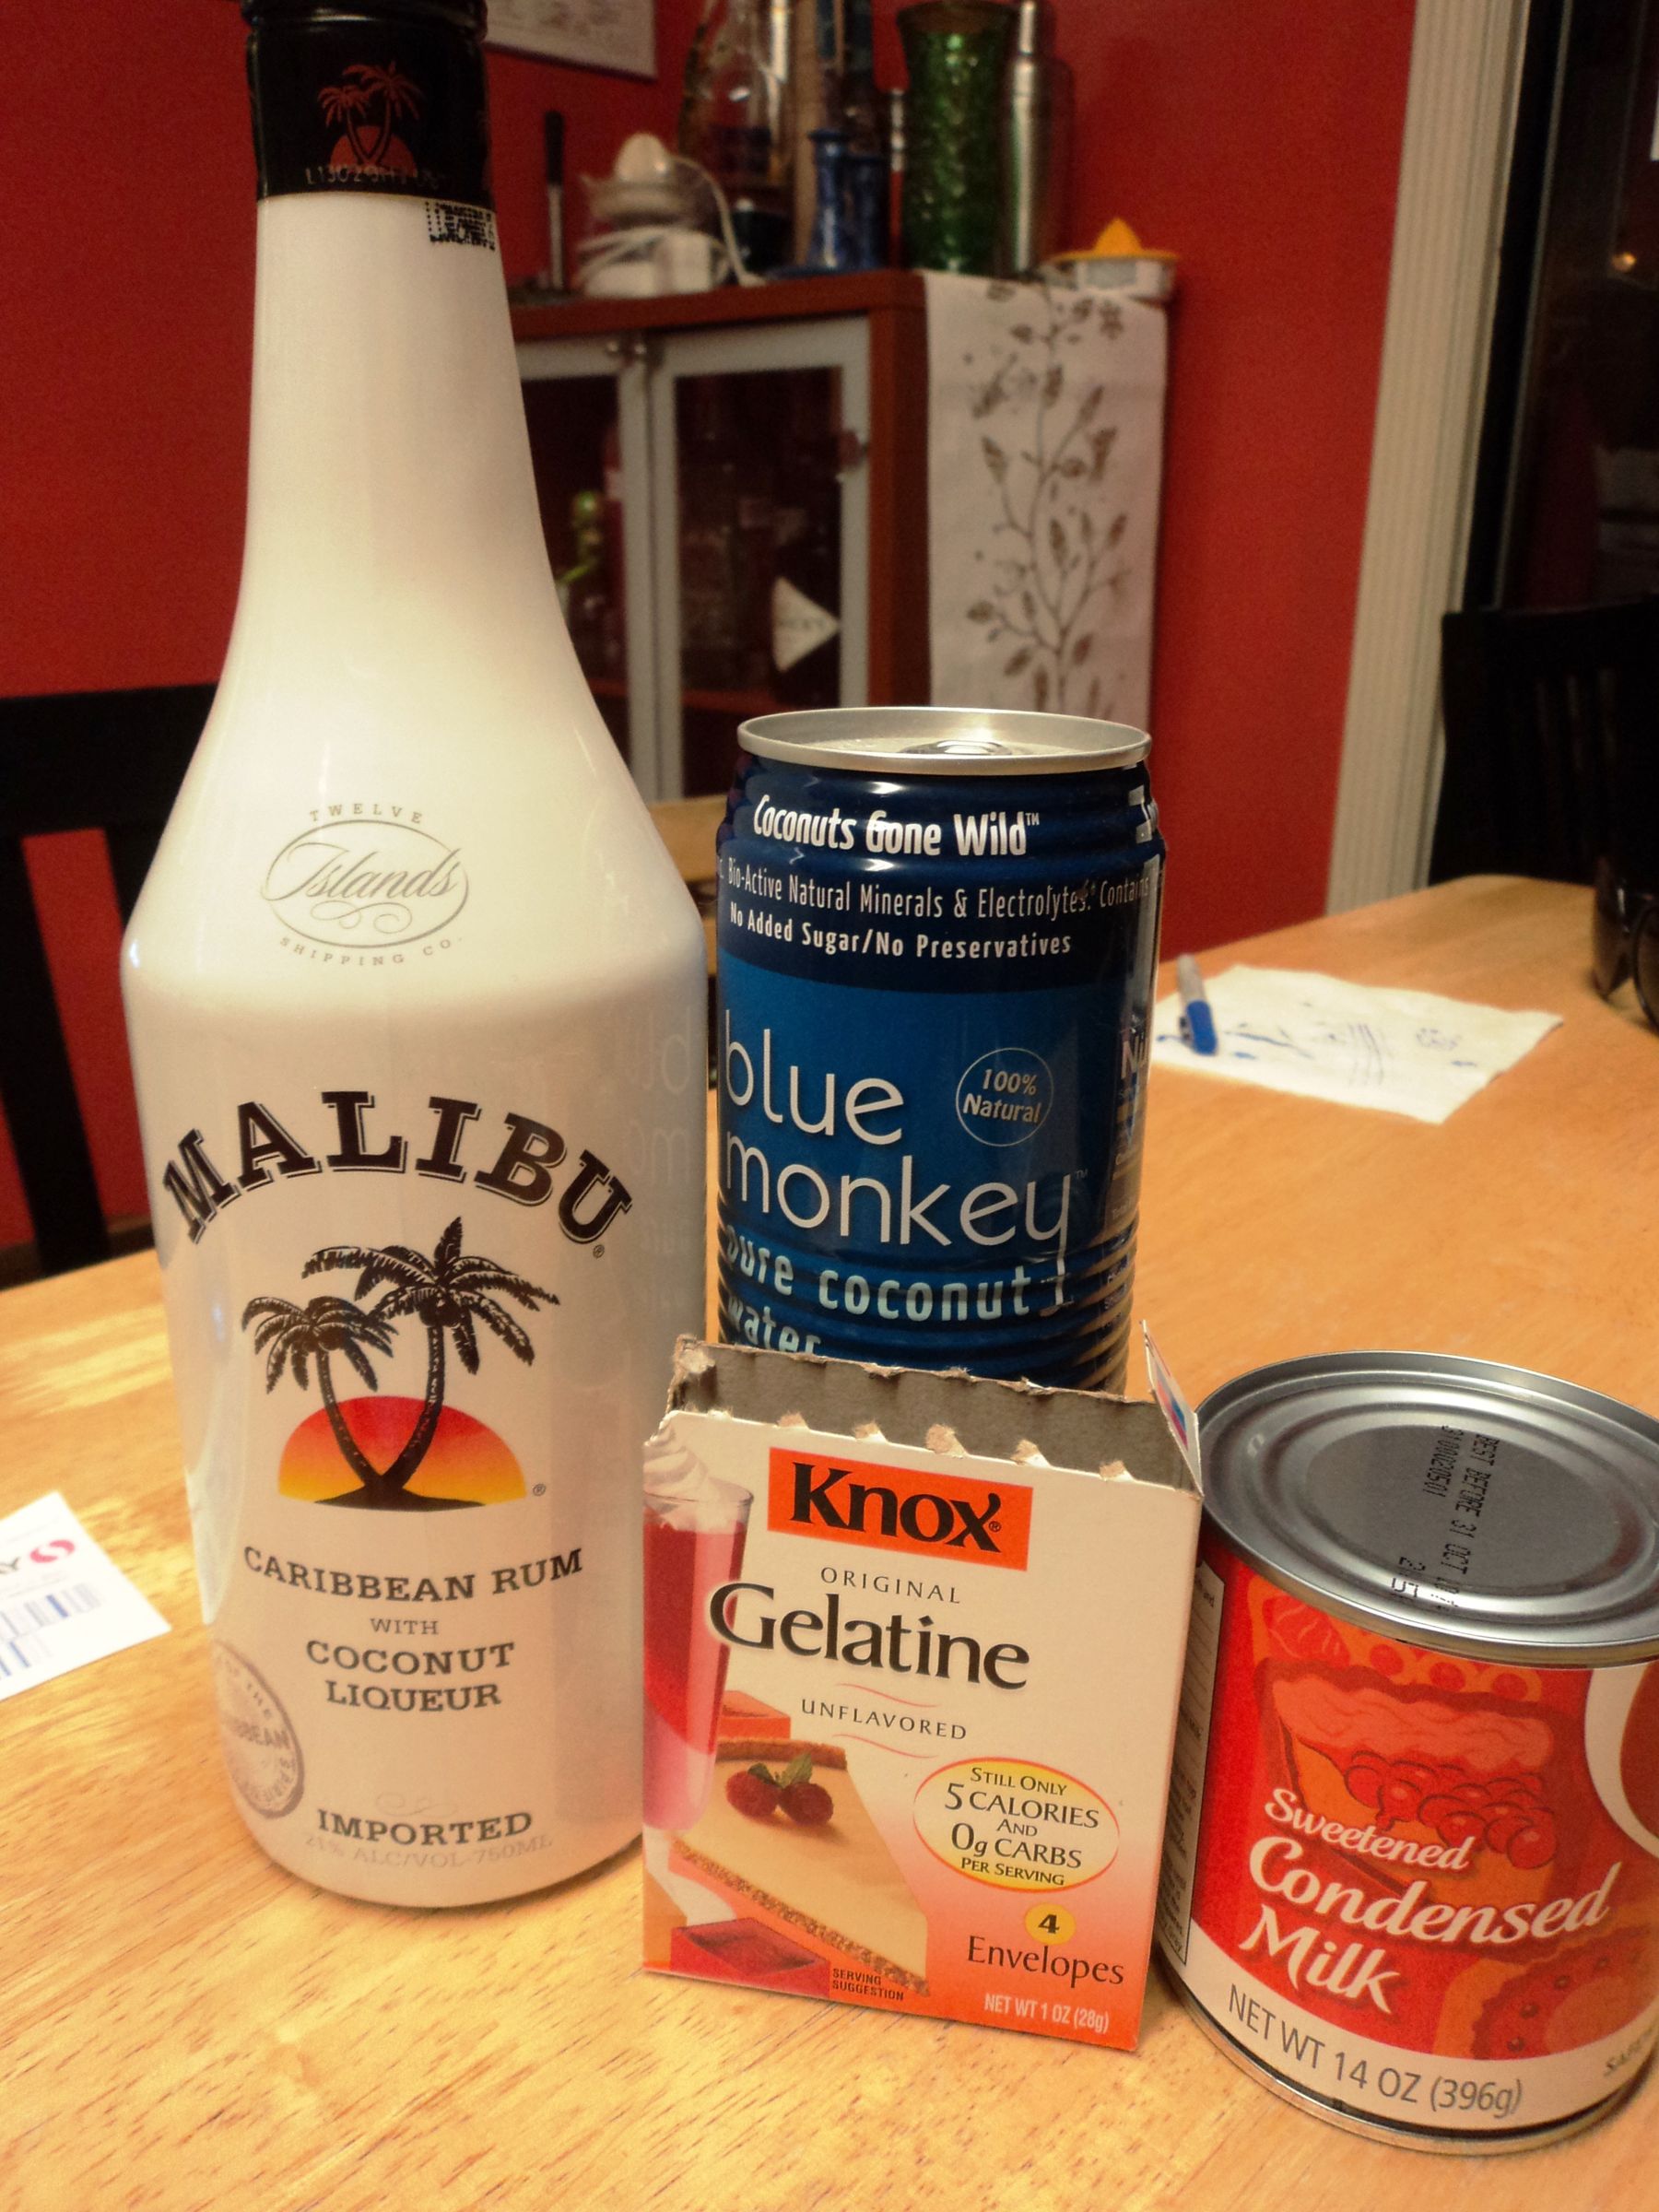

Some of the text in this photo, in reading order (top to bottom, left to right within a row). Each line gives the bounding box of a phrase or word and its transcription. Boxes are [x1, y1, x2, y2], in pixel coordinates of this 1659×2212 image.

[310, 803, 423, 825] TWELVE
[753, 794, 858, 850] Coconuts
[865, 809, 942, 855] Gone
[261, 841, 462, 901] Islands
[728, 856, 782, 900] Bio-Active
[788, 873, 851, 912] Natural
[860, 882, 944, 919] Minerals
[953, 888, 968, 919] &
[1100, 876, 1149, 908] Contains
[730, 900, 1072, 959] No Added Sugar/No Preservatives
[280, 936, 406, 967] SHIPPING
[724, 1008, 905, 1147] blue
[982, 1068, 1037, 1096] 100%
[962, 1092, 1042, 1124] Natural
[162, 1090, 633, 1244] MALIBU
[725, 1130, 1072, 1312] monkey
[818, 1265, 1031, 1323] coconut
[1470, 1433, 1500, 1467] BEST
[790, 1462, 1002, 1553] Knox
[1454, 1466, 1492, 1518] BEFORE
[1449, 1519, 1477, 1539] 31
[243, 1546, 583, 1602] CARIBBEAN RUM
[1441, 1542, 1472, 1575] OCT
[820, 1566, 960, 1605] ORIGINAL
[371, 1617, 440, 1636] WITH
[709, 1582, 1030, 1690] Gelatine
[306, 1639, 515, 1676] COCONUT
[325, 1679, 502, 1712] LIQUEUR
[801, 1698, 968, 1741] UNFLAVORED
[970, 1767, 1067, 1796] STILL ONLY
[317, 1808, 533, 1846] IMPORTED
[945, 1783, 1100, 1829] 5 CALORIES
[996, 1818, 1038, 1837] AND
[951, 1822, 1082, 1869] 0g CARBS
[1264, 1788, 1476, 1871] Sweetened
[960, 1857, 1065, 1886] PER SERVING
[1249, 1835, 1622, 1945] Condensed
[1038, 1913, 1061, 1935] 4
[832, 1967, 882, 1986] SERVING
[968, 1936, 1124, 1988] Envelopes
[1239, 1904, 1400, 2014] Milk
[831, 1979, 904, 2001] SUGGESTION
[983, 1993, 1110, 2034] NET WT 1 OZ (28g)
[1228, 1983, 1524, 2118] NET WT 14 OZ (396g)
